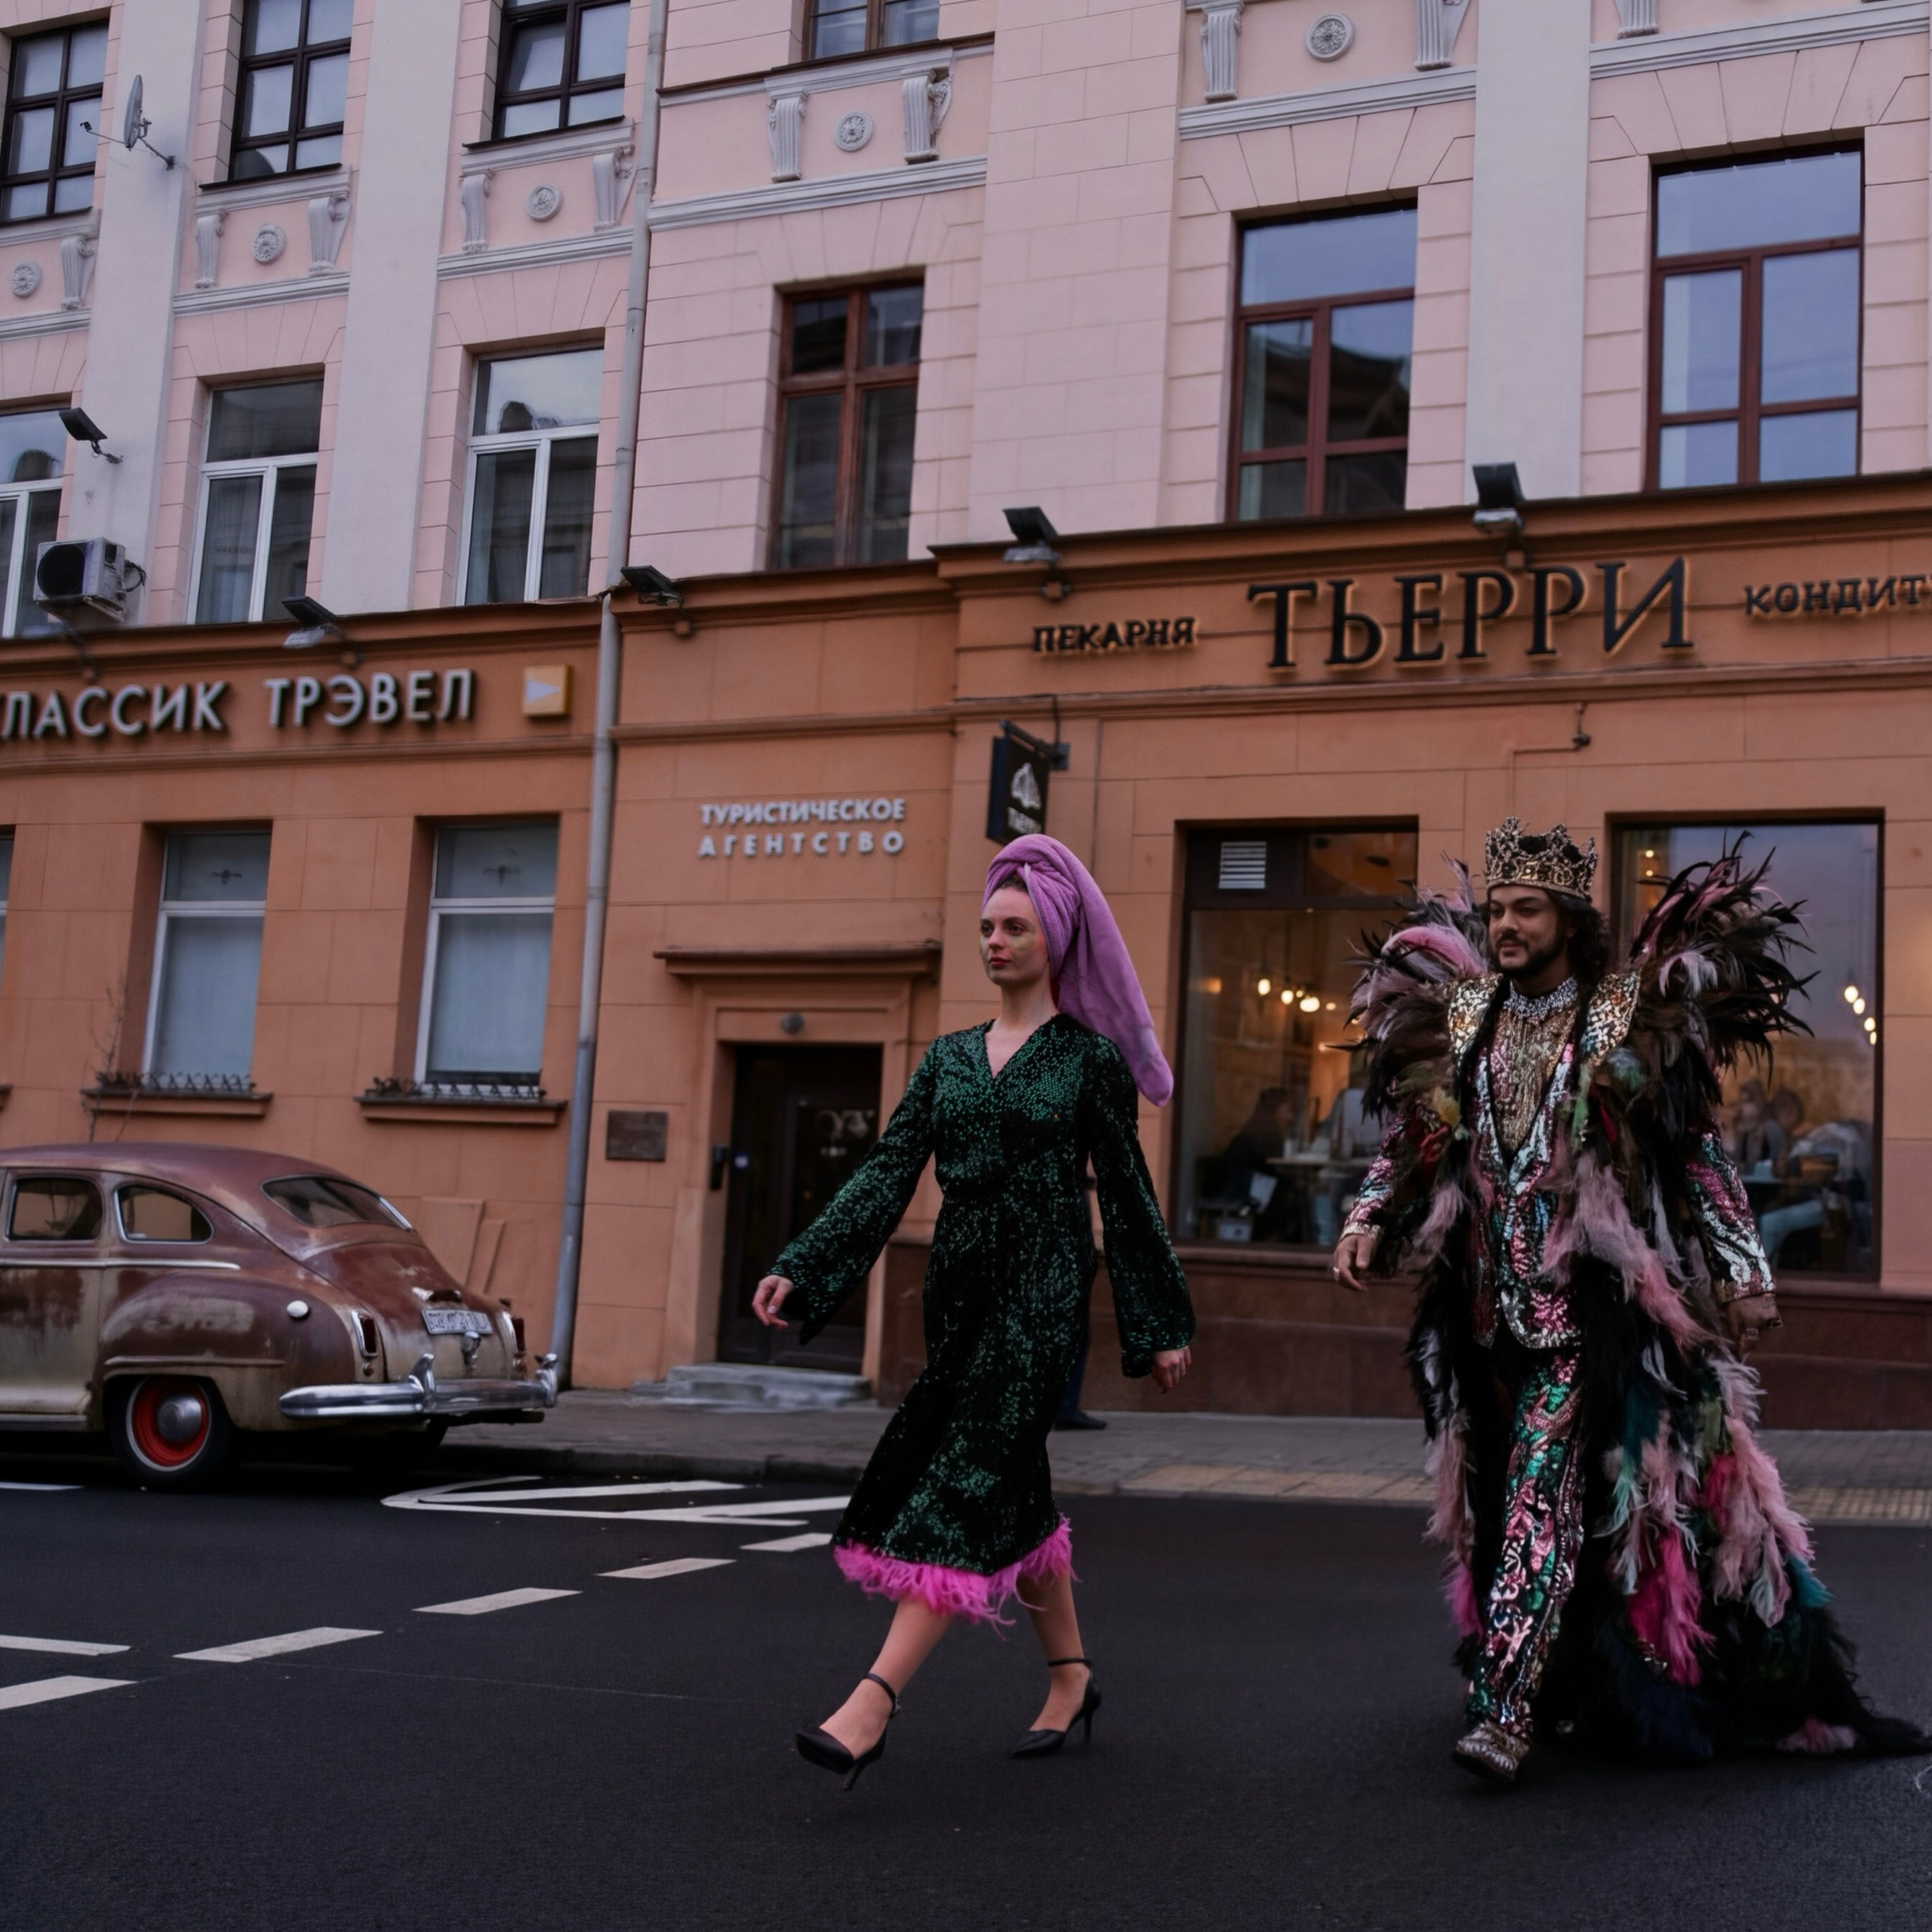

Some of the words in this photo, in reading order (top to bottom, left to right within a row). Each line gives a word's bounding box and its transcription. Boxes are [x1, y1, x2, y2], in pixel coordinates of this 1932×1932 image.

[1033, 616, 1196, 652] ПЕКАРНЯ
[1247, 556, 1694, 669] ТЬЕРРИ
[1744, 573, 1932, 615] КОНДИТ
[263, 668, 472, 728] ТРЭВЕЛ
[700, 797, 906, 826] ТУРИСТИЧЕСКОЕ
[698, 830, 904, 857] АГЕНТСТВО
